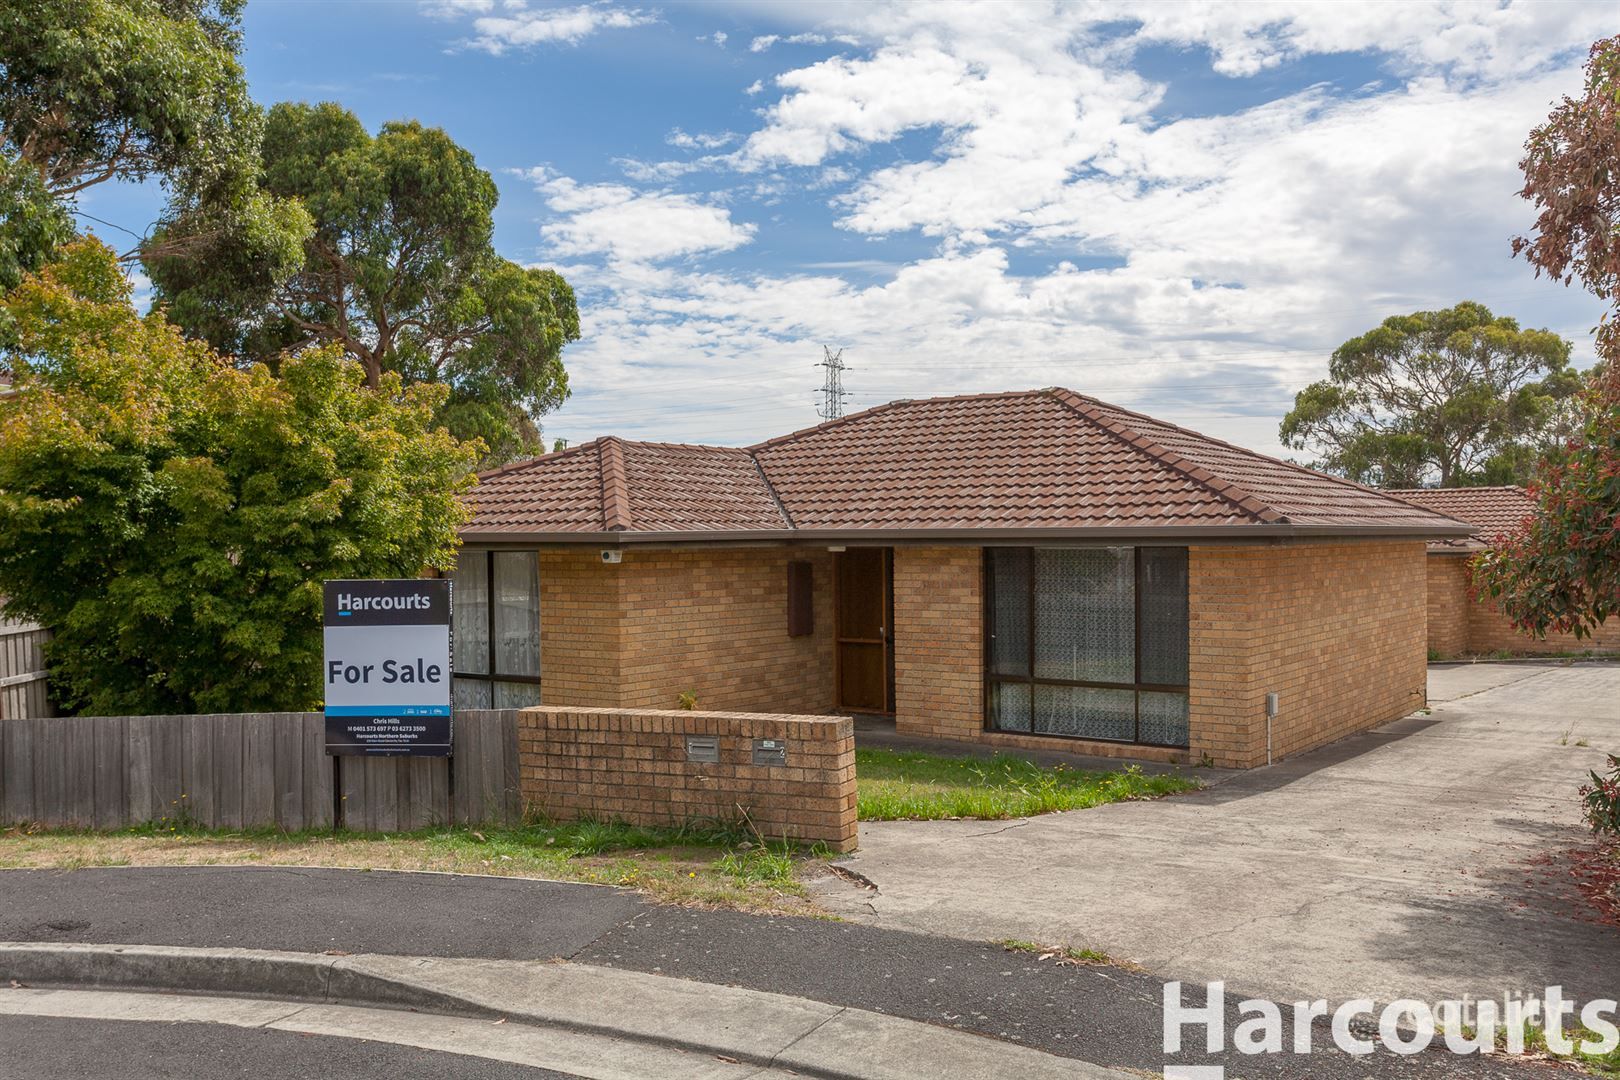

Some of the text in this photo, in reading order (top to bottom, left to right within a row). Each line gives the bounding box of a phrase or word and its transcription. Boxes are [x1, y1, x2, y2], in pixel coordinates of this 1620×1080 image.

[337, 593, 431, 610] Harcourts
[328, 658, 441, 684] For Sale
